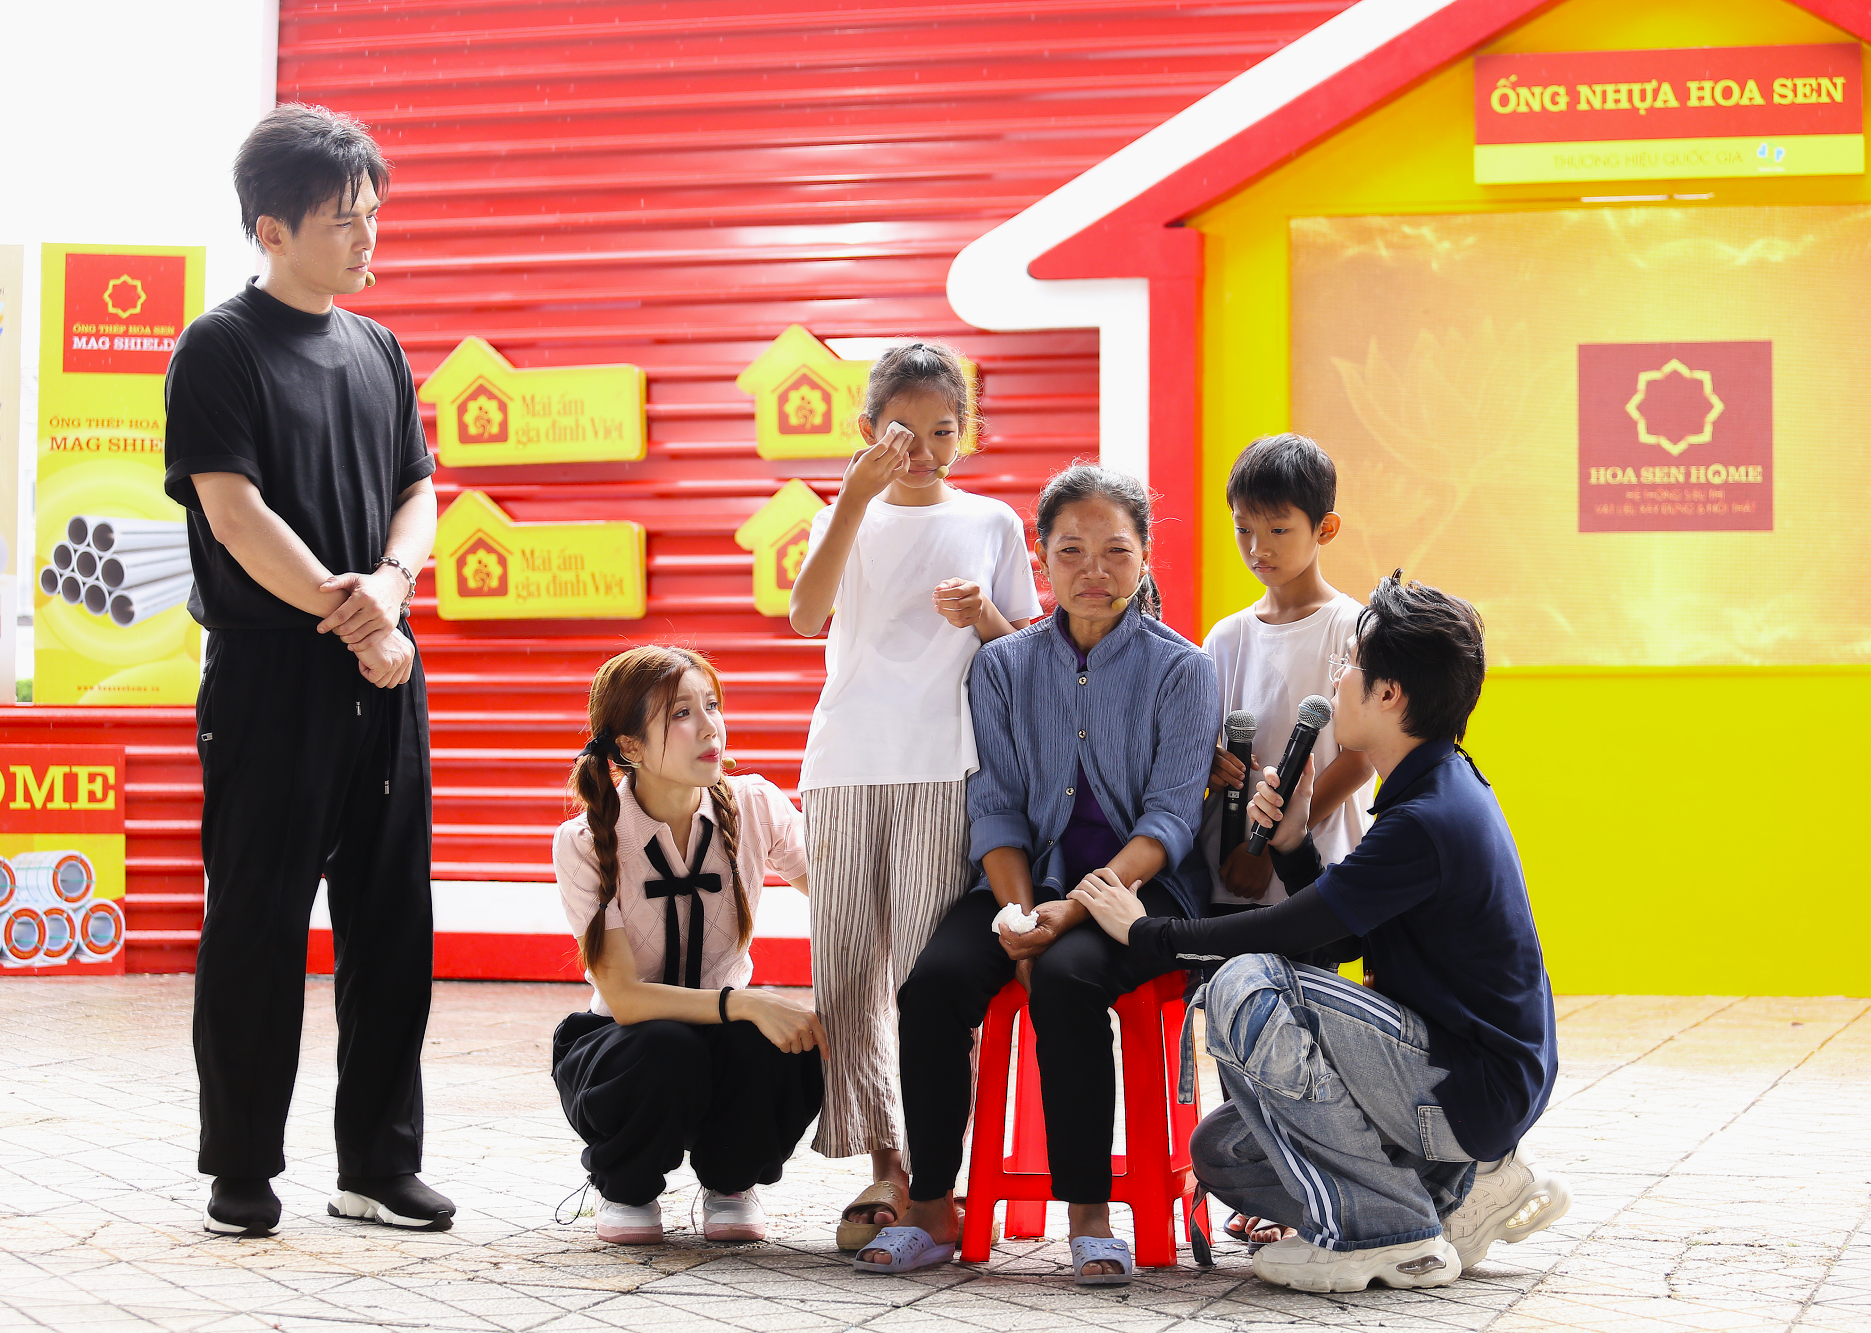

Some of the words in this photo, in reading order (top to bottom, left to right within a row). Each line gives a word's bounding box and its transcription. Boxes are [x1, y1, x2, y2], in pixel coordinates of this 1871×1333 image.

[1490, 74, 1569, 114] ỐNG
[1577, 79, 1679, 116] NHỰA
[1686, 79, 1766, 108] HOA
[1772, 76, 1846, 106] SEN
[128, 324, 151, 335] HOA
[153, 325, 175, 336] SEN
[72, 336, 110, 350] MAG
[113, 336, 175, 351] SHIELD
[129, 418, 160, 430] HOA
[49, 436, 101, 452] MAG
[108, 437, 163, 453] SHIE
[1589, 466, 1638, 485] HOA
[1640, 465, 1686, 485] SEN
[1689, 463, 1763, 485] HOME
[0, 765, 116, 810] ME
